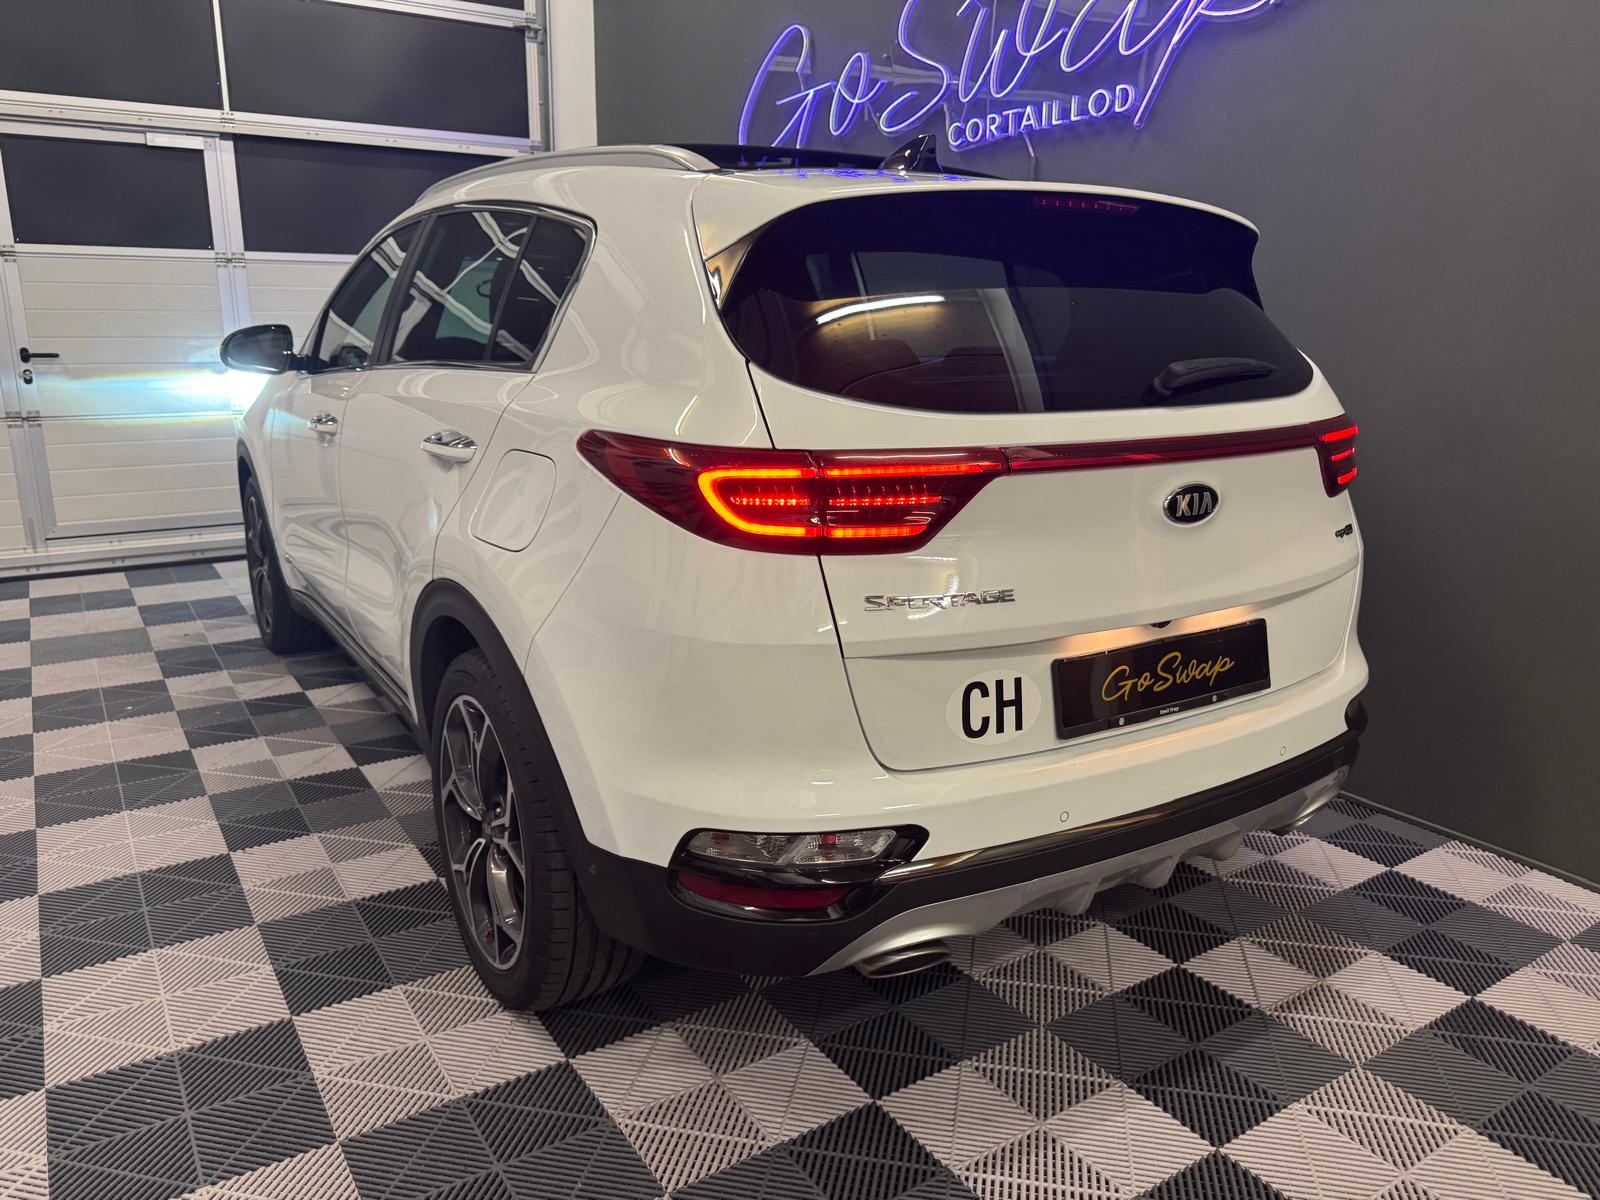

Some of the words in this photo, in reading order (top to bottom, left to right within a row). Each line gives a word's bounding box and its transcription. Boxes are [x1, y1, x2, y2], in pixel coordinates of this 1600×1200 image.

[948, 84, 1136, 147] CORTAILLOD
[1175, 491, 1213, 517] KIA
[863, 588, 1016, 612] SPORTAGE
[961, 676, 1023, 739] CH
